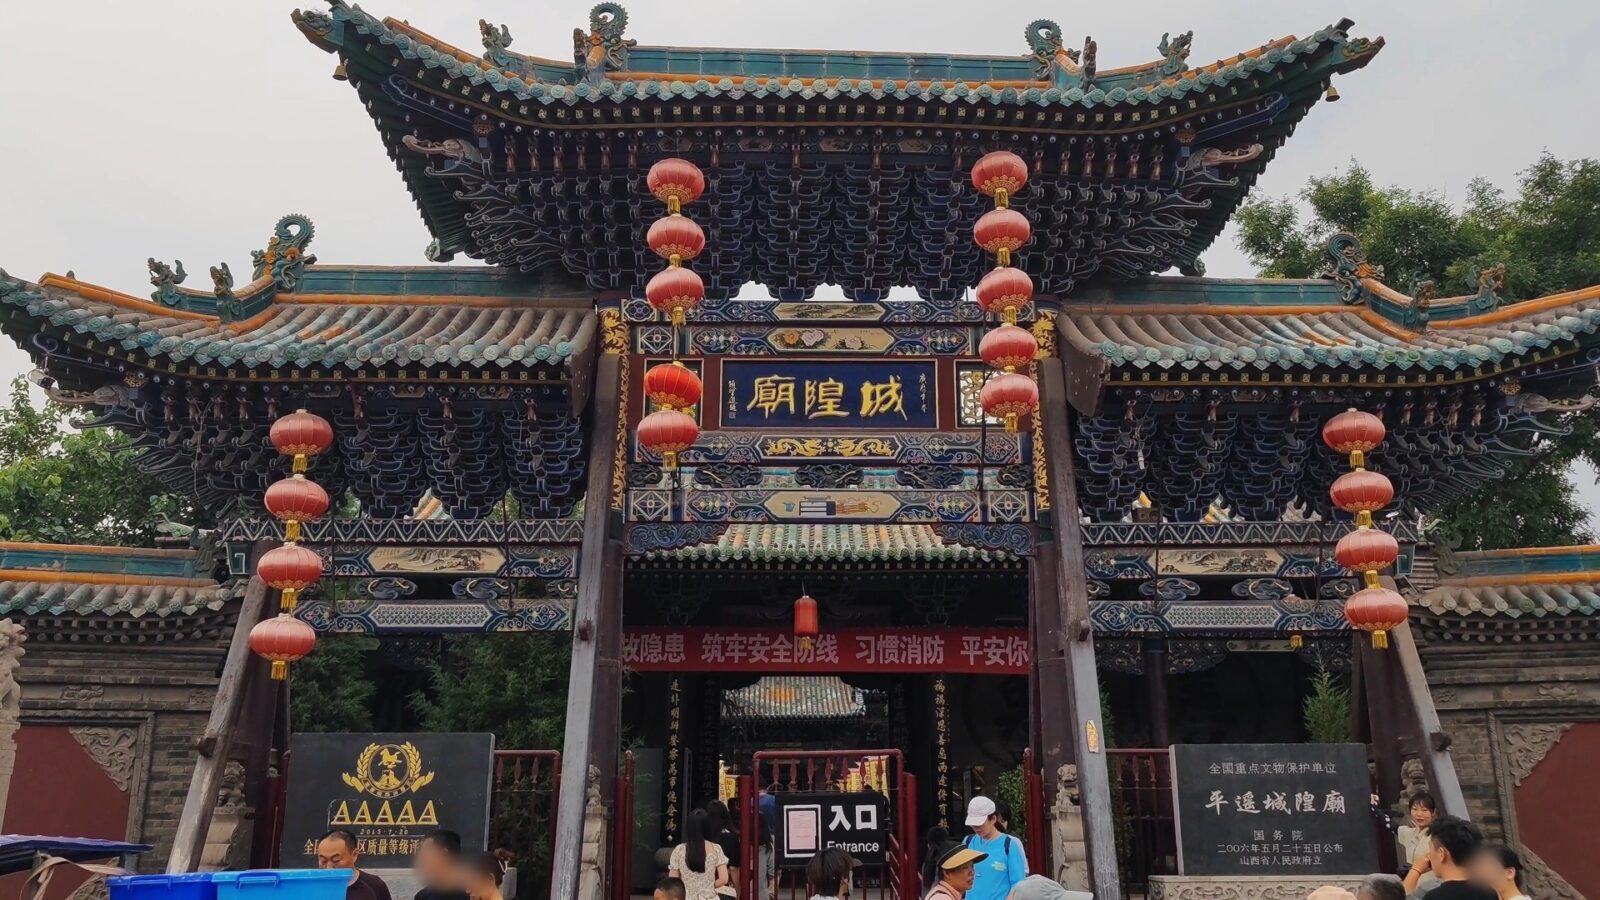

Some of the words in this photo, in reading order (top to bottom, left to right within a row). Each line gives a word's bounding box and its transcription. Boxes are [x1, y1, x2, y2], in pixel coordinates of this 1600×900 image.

[701, 633, 840, 664] 筑牢安全防线
[855, 634, 945, 665] 习惯消防
[960, 636, 1029, 667] 平安你
[1208, 762, 1337, 775] 全国重点文物保护单位
[330, 800, 438, 825] AAAAA
[828, 804, 878, 831] 入口
[1253, 830, 1303, 841] 国务院
[1240, 855, 1323, 865] 山西省人民政府立
